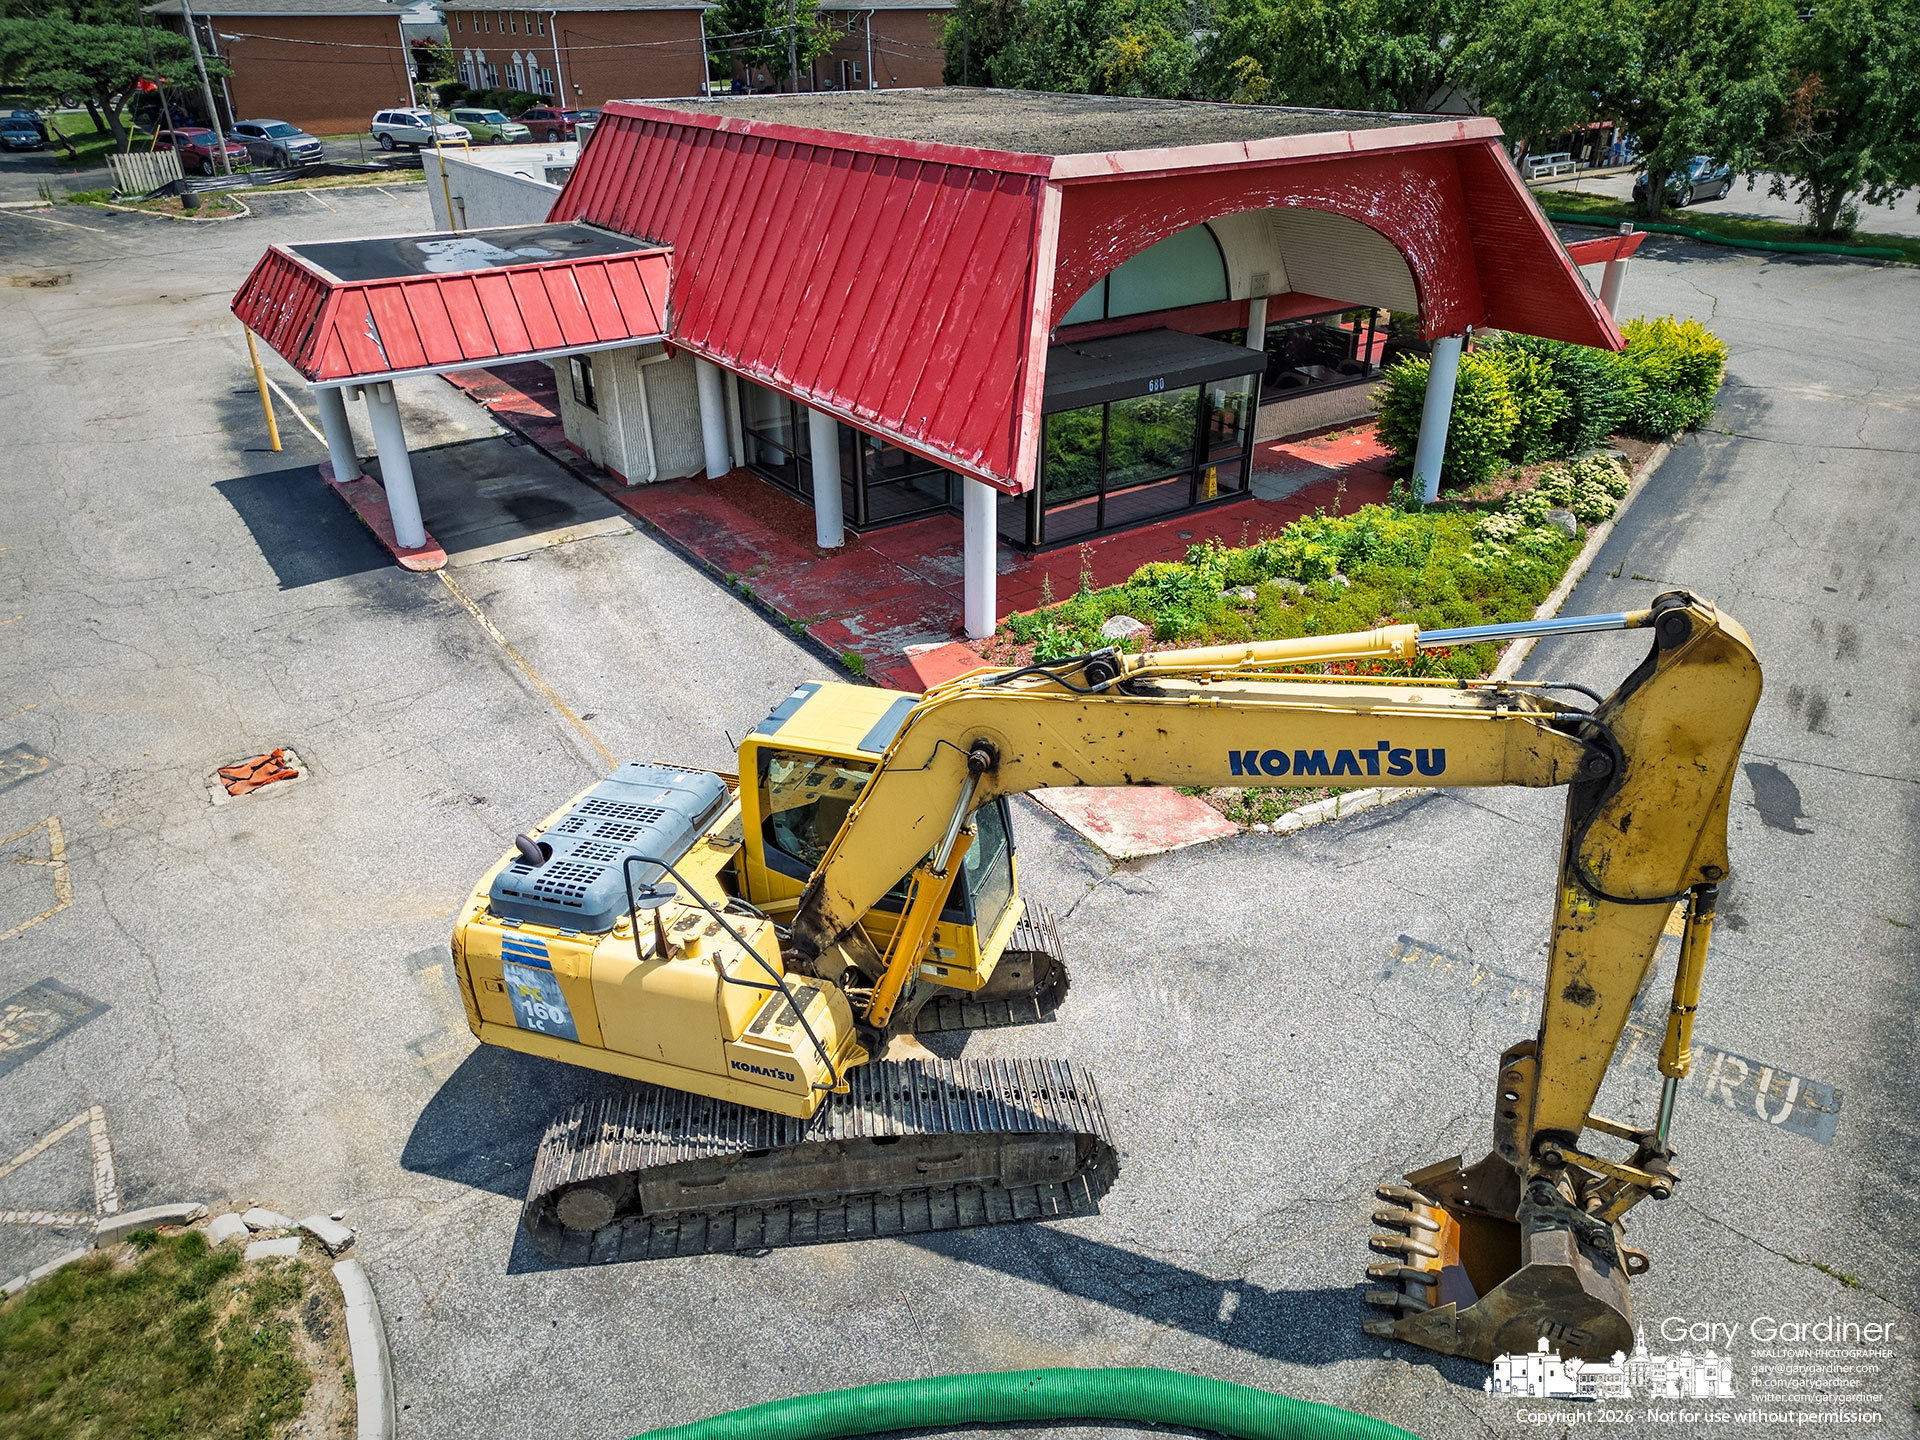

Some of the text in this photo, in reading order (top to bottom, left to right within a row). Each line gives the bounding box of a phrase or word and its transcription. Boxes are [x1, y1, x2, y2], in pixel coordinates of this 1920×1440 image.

[1148, 377, 1165, 392] 680
[1228, 740, 1447, 777] KOMATSU
[522, 1000, 565, 1024] 160
[527, 1017, 545, 1031] LC
[730, 1060, 795, 1082] KOMATSU
